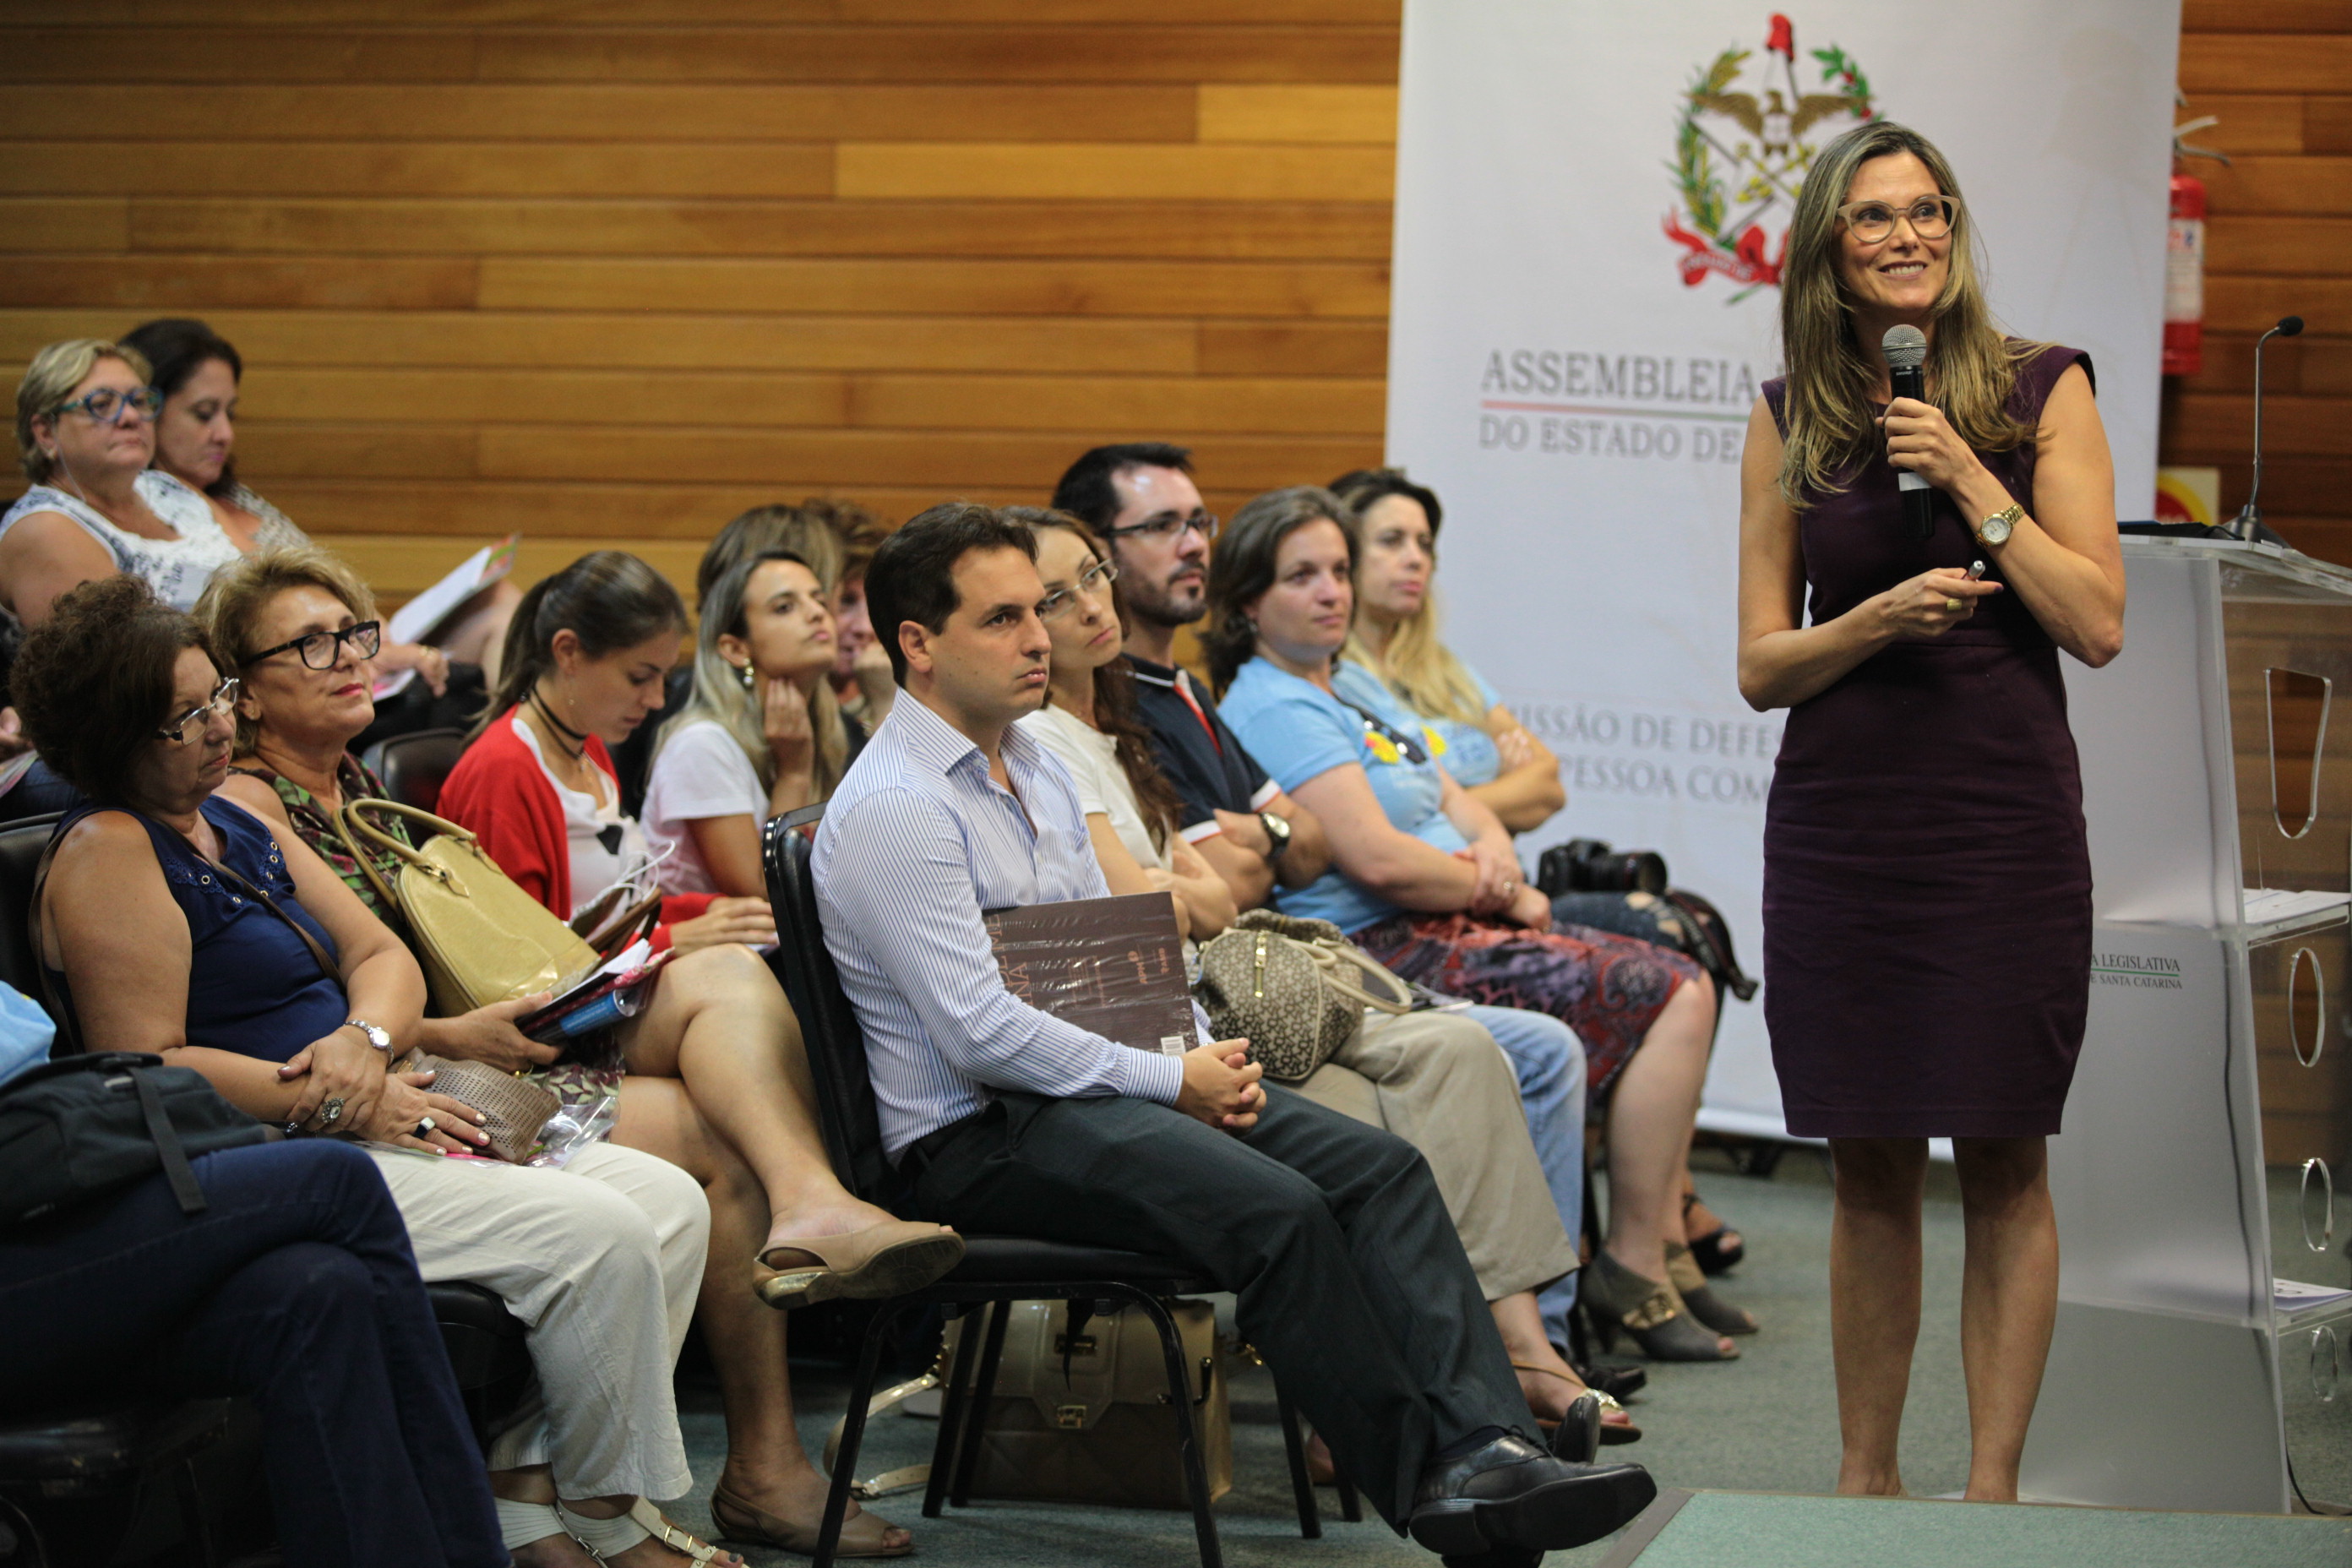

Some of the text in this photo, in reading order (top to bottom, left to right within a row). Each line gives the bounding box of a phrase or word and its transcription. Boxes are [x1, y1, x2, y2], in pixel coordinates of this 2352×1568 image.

[1480, 348, 1756, 405] ASSEMBLEIA
[1478, 414, 1742, 464] DO ESTADO DE
[1509, 700, 1620, 747] ISSÃO
[1631, 712, 1677, 752] DE
[2100, 974, 2131, 988] SANTA
[2134, 976, 2183, 989] CATARINA
[2102, 954, 2180, 972] LEGISLATIVA
